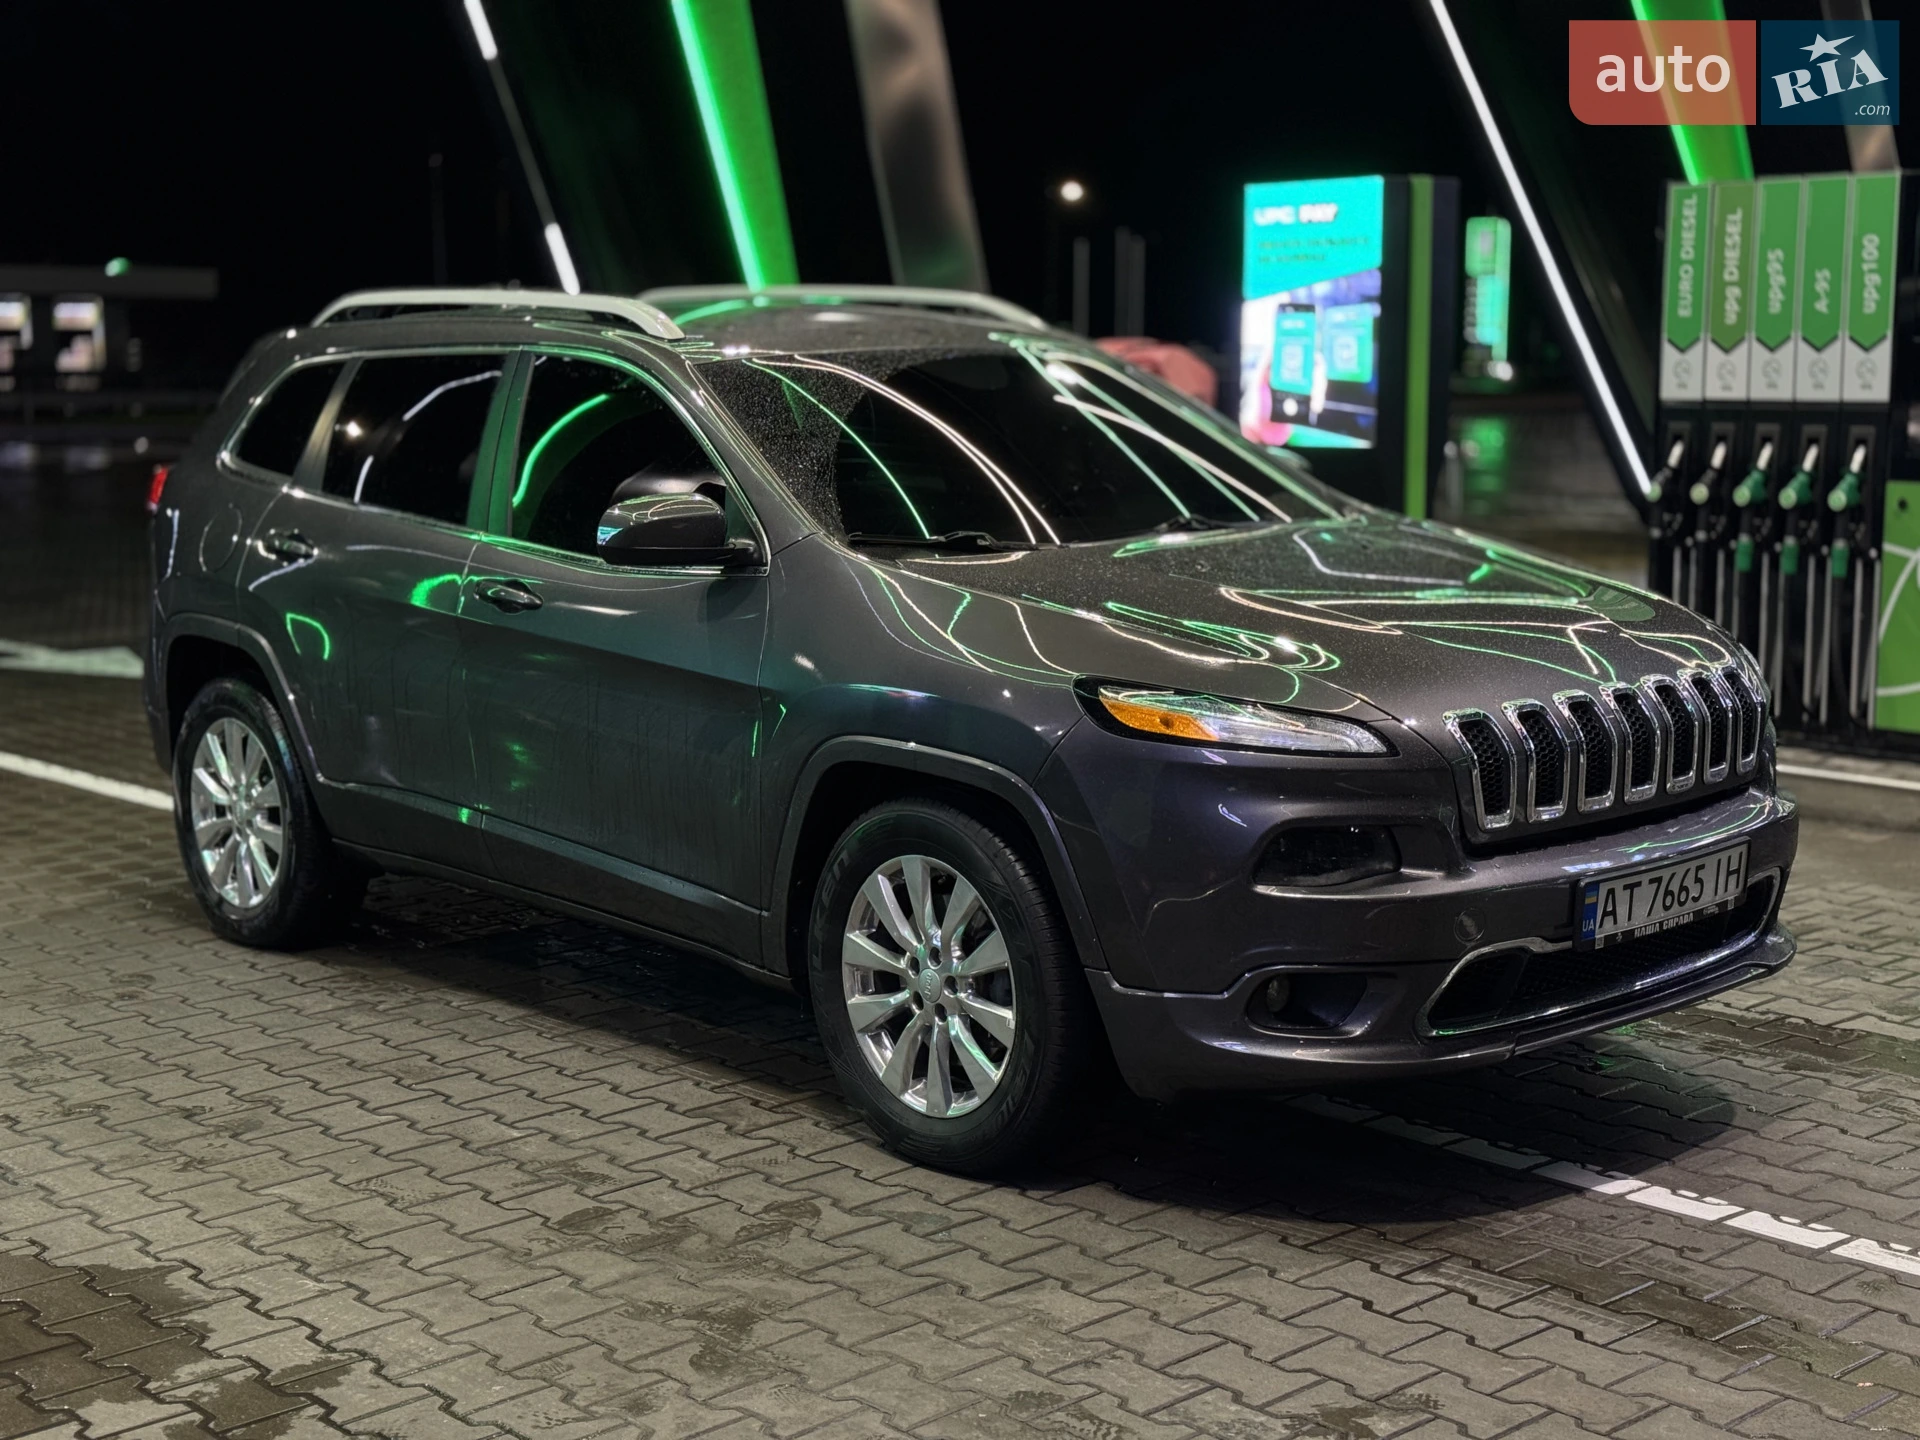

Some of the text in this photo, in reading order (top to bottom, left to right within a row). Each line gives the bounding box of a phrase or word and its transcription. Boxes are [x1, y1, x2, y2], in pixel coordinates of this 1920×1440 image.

[1676, 193, 1698, 318] EURO DIESEL
[1722, 207, 1743, 325] upg DIESEL
[1766, 248, 1787, 314] upg95
[1813, 267, 1832, 314] A-95
[1860, 233, 1882, 314] upg100
[1582, 919, 1595, 932] UA
